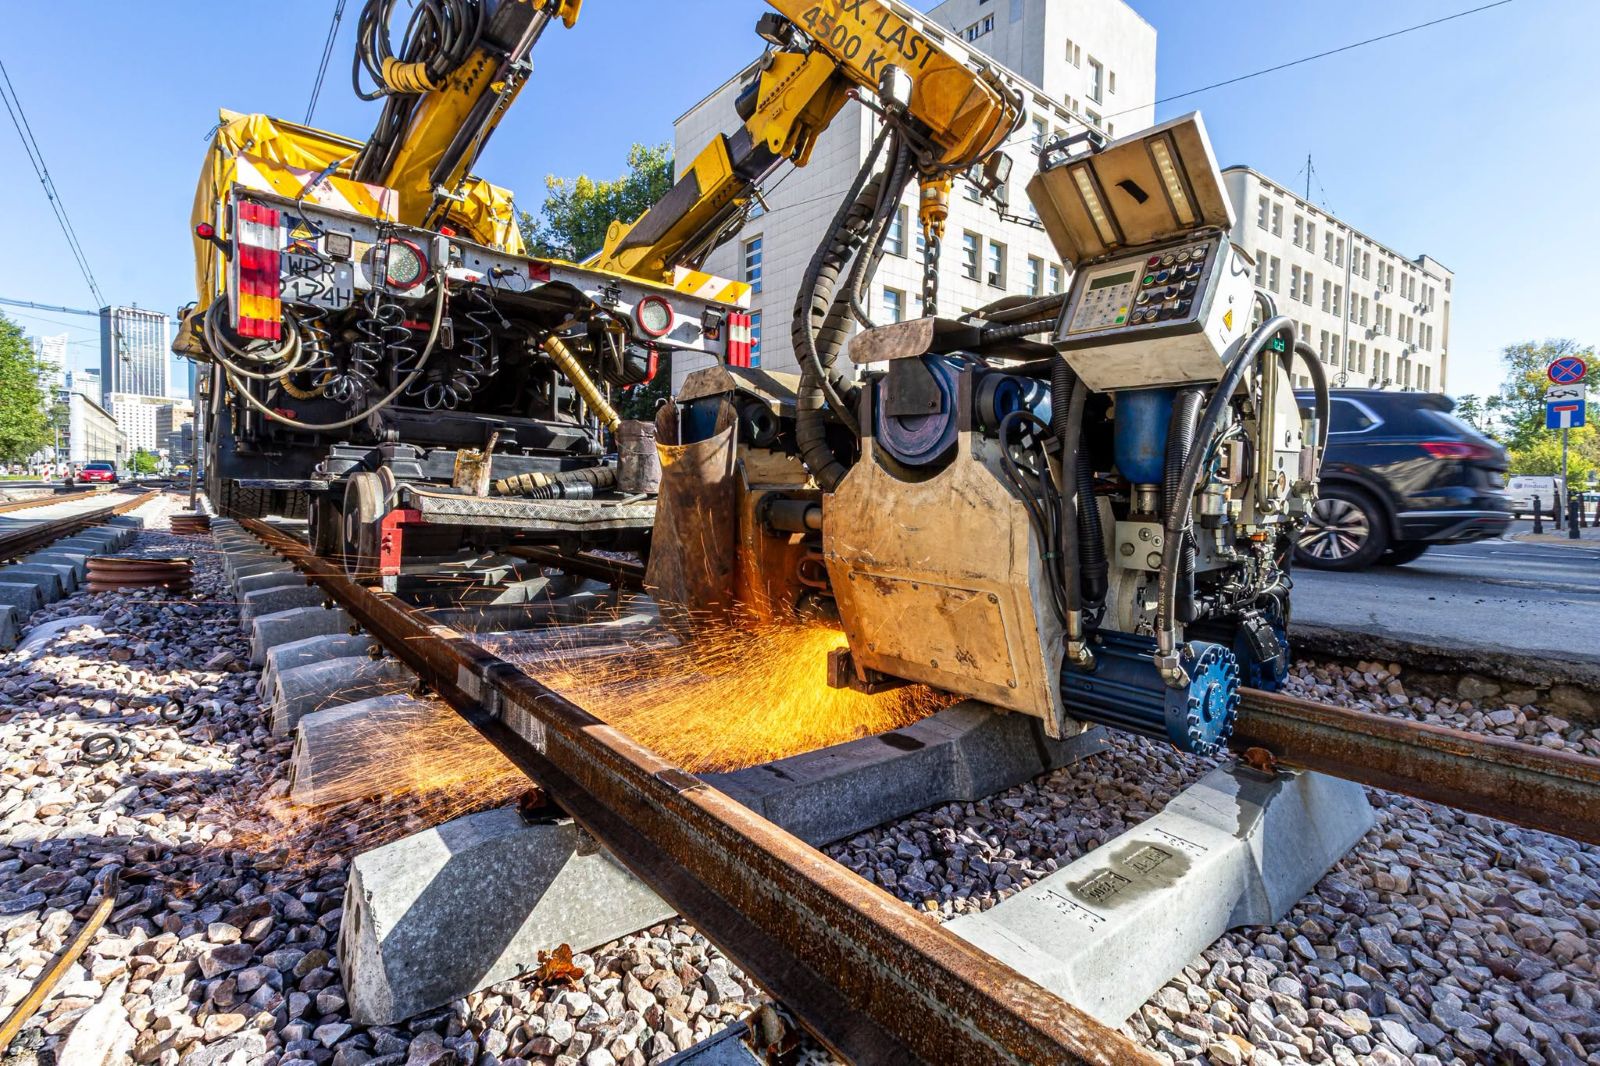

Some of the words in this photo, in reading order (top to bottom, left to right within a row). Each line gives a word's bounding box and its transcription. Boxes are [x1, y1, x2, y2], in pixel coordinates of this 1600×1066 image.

[802, 6, 862, 60] 4500
[862, 49, 886, 79] K
[875, 13, 939, 69] LAST
[288, 255, 336, 284] WPR
